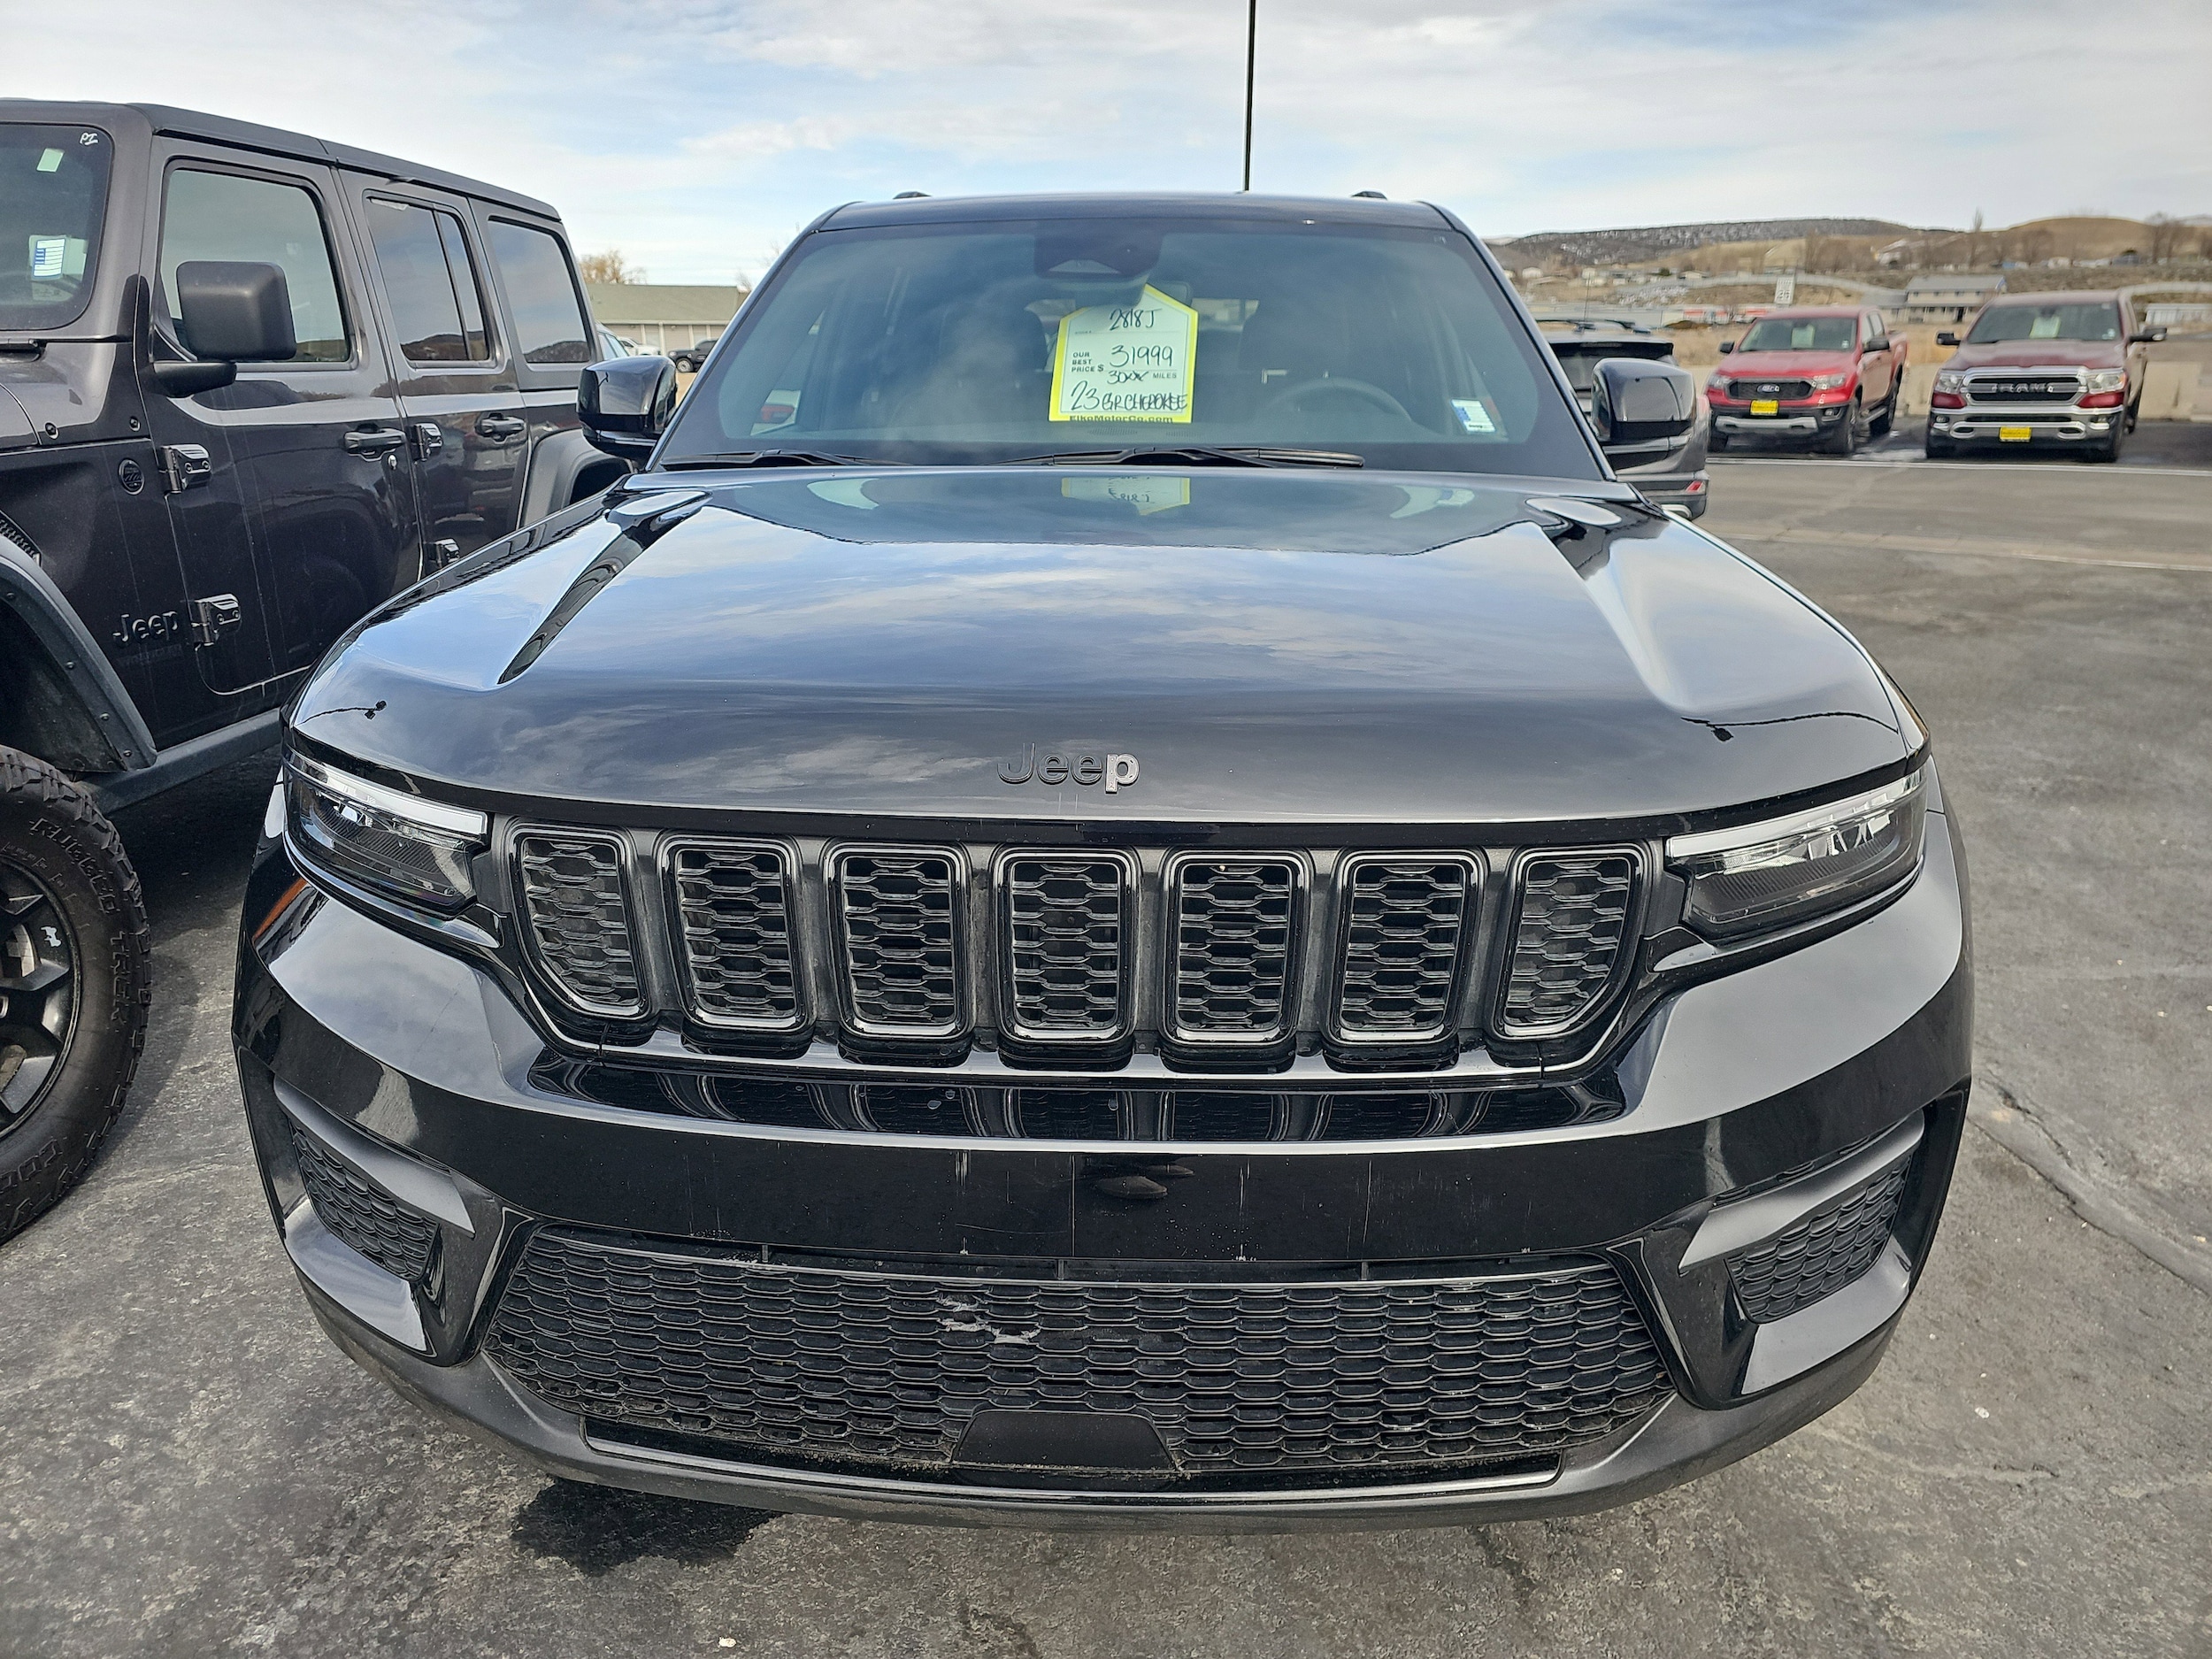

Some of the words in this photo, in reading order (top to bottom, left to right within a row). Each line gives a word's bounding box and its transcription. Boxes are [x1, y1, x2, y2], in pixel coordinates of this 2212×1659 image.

[1110, 344, 1173, 367] 31999
[1071, 380, 1100, 411] 23
[111, 611, 178, 648] Jeep
[996, 742, 1141, 795] Jeep
